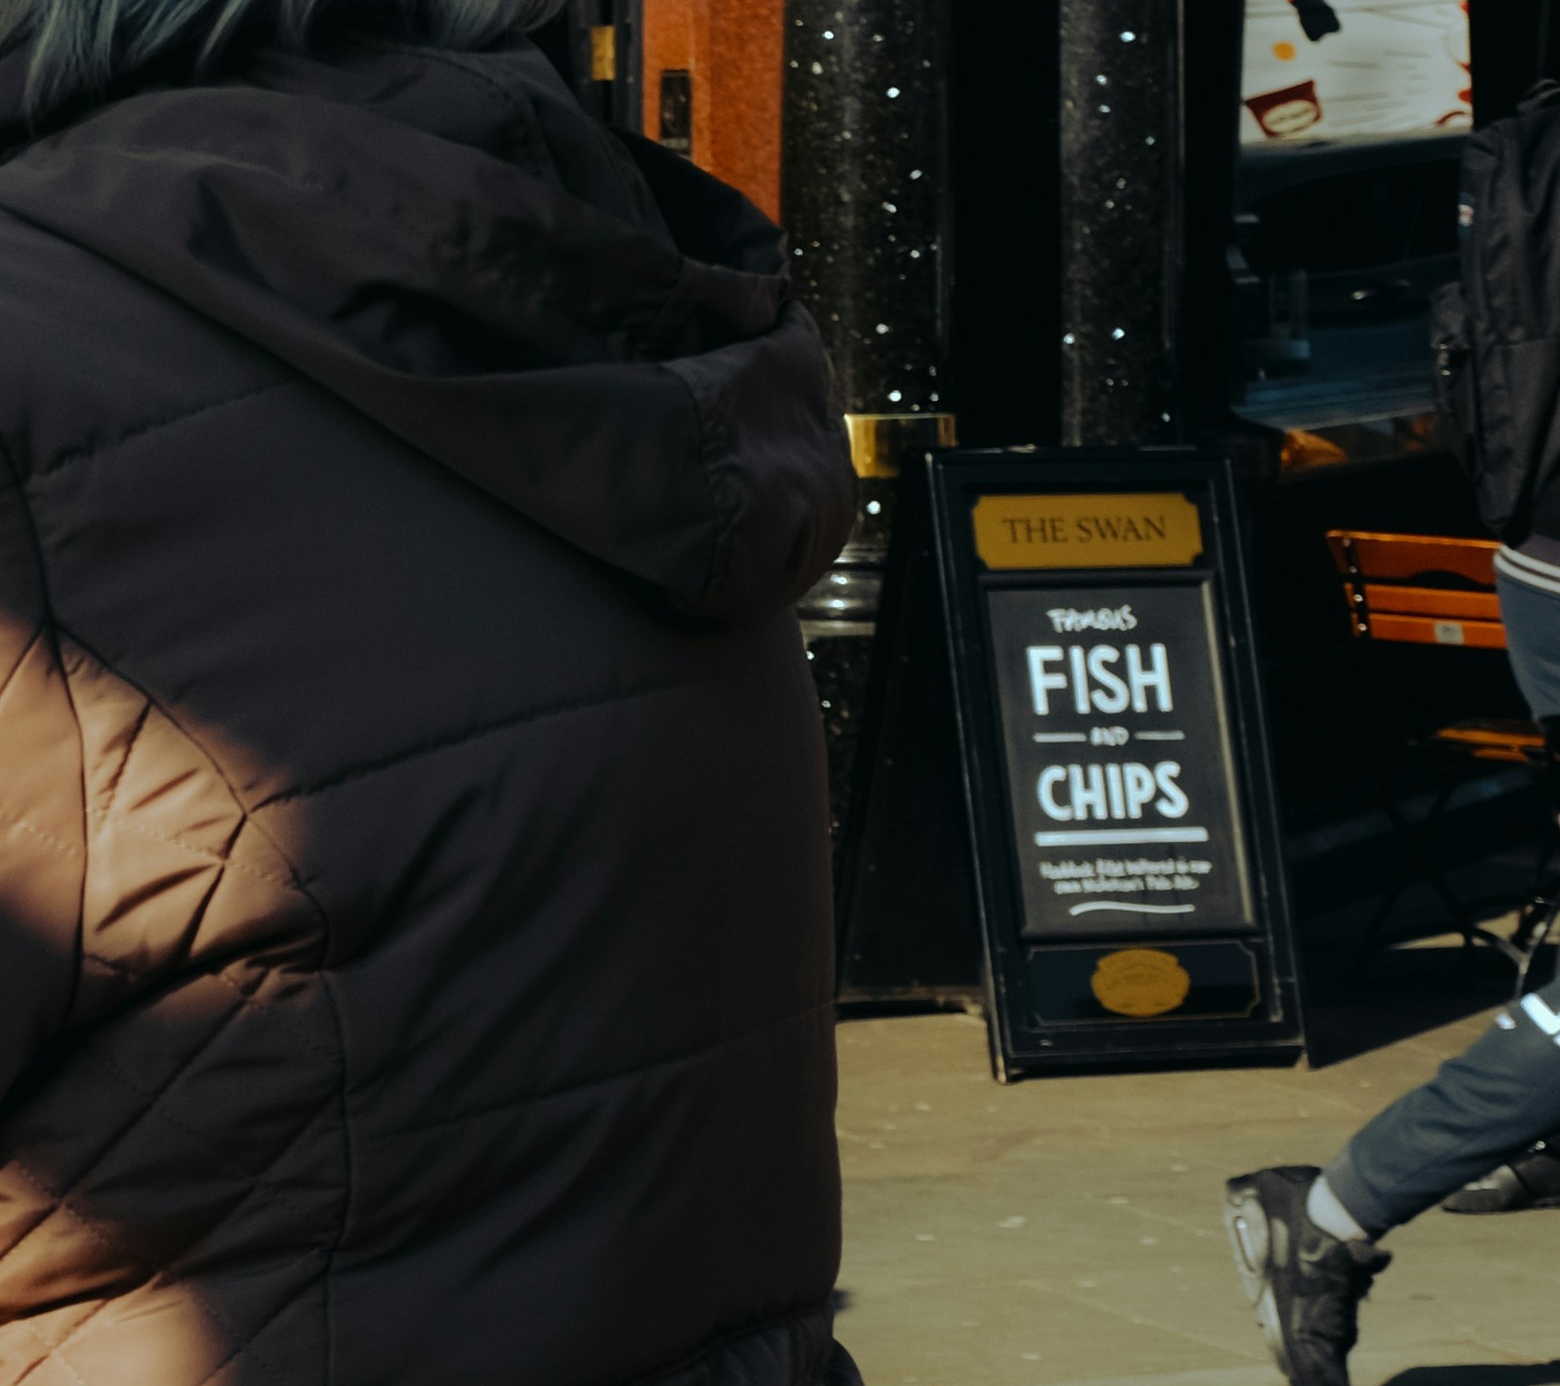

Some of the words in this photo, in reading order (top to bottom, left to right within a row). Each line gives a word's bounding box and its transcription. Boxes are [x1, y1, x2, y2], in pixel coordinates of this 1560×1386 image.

[1002, 517, 1069, 545] THE
[1076, 514, 1167, 543] SWAN
[1026, 642, 1175, 716] FISH
[1037, 761, 1190, 822] CHIPS
